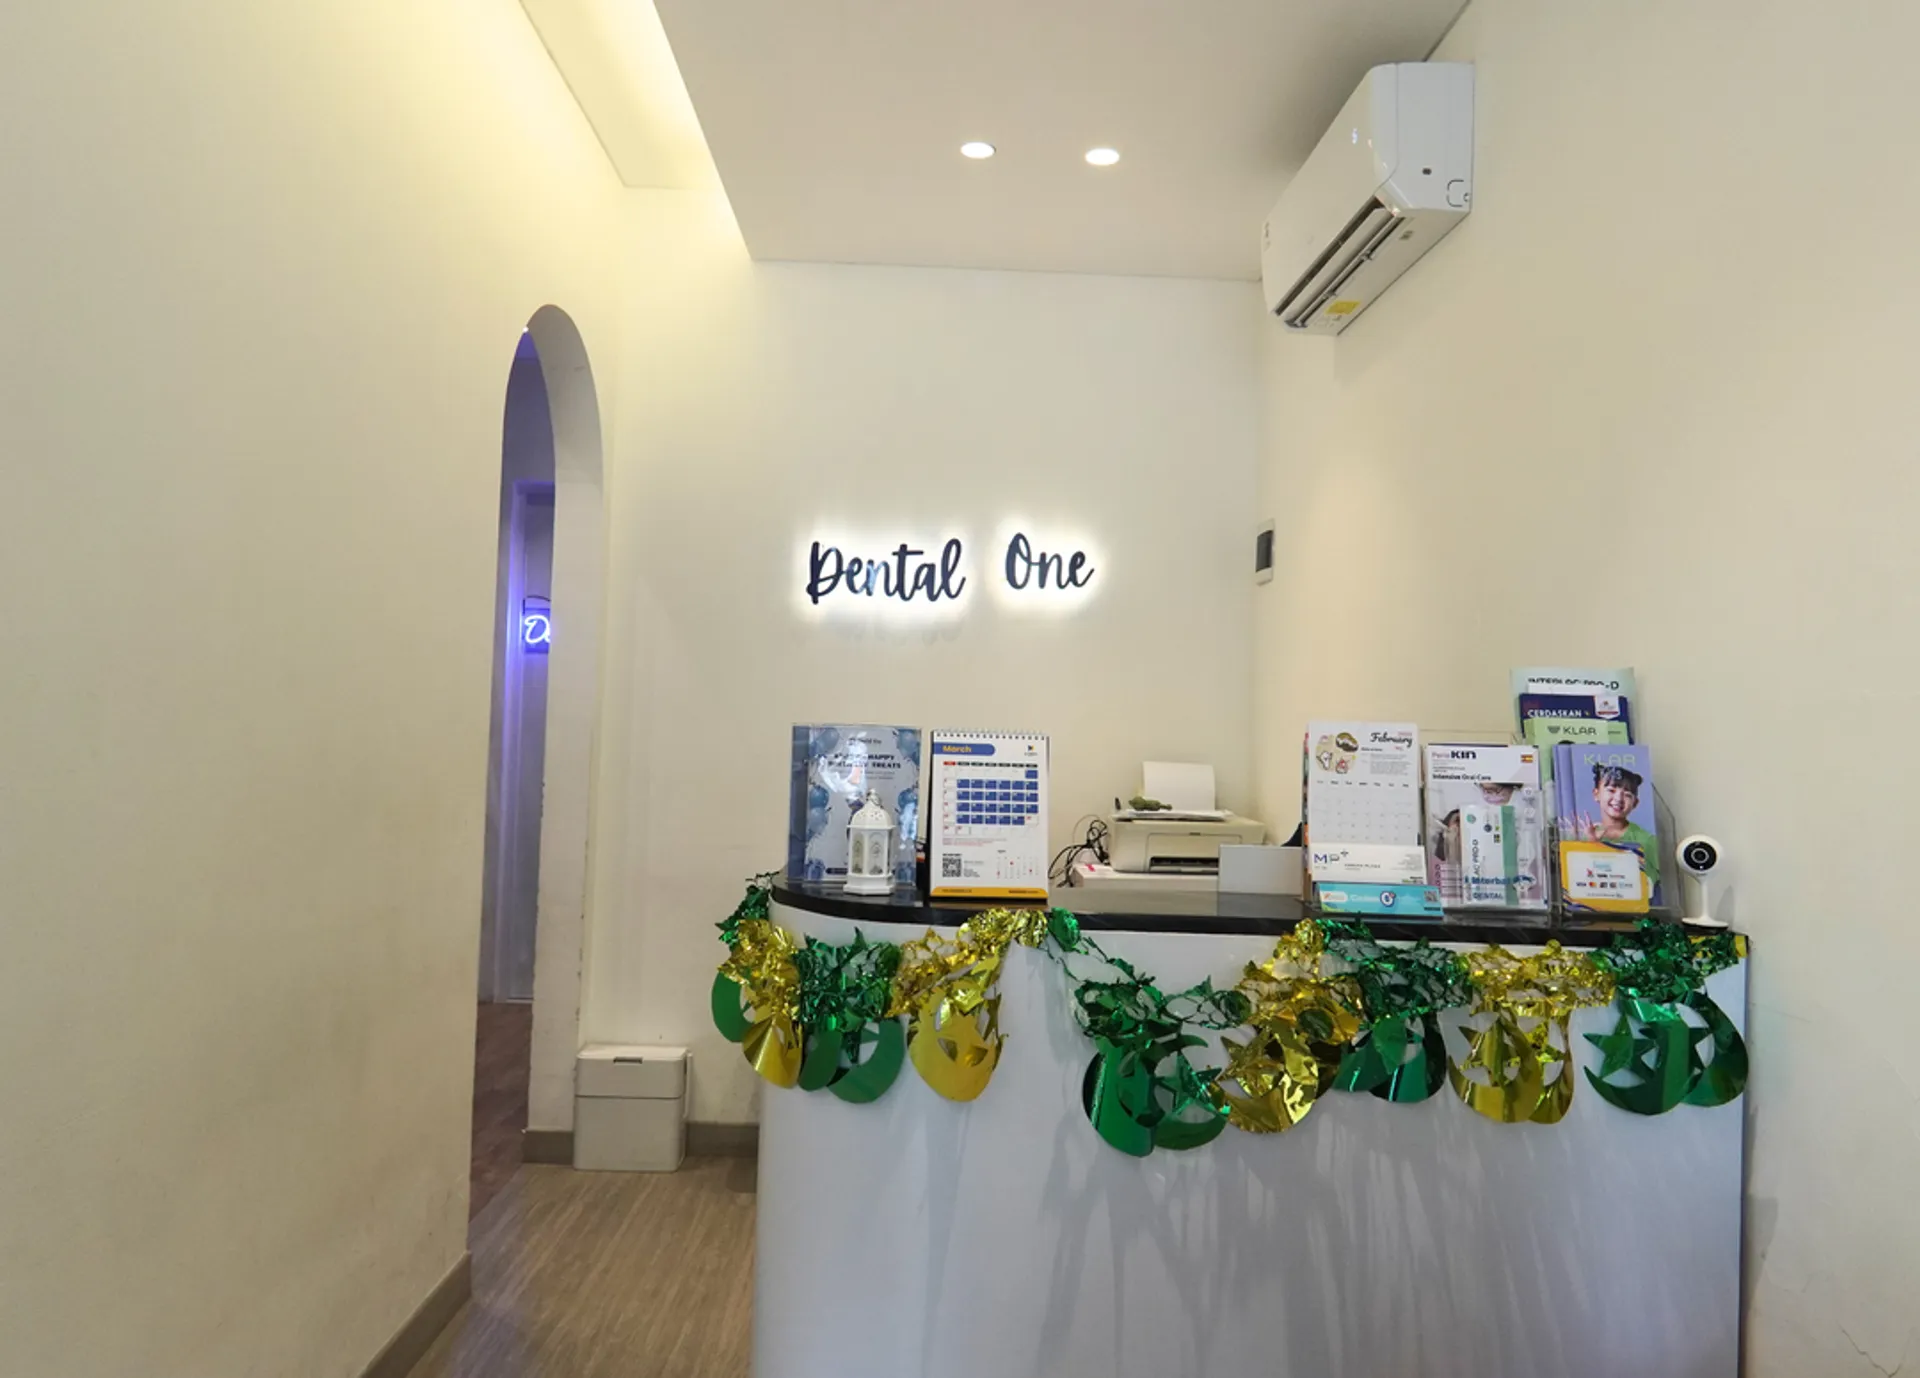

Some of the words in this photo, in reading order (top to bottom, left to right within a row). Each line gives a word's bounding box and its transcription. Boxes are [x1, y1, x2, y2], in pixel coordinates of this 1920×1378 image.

[806, 538, 966, 605] Dental
[1005, 532, 1095, 590] One
[1527, 709, 1582, 718] CERDASKAN
[1562, 726, 1598, 736] KLAR
[1370, 731, 1413, 749] February
[942, 745, 972, 753] March
[1583, 752, 1637, 768] KLAR
